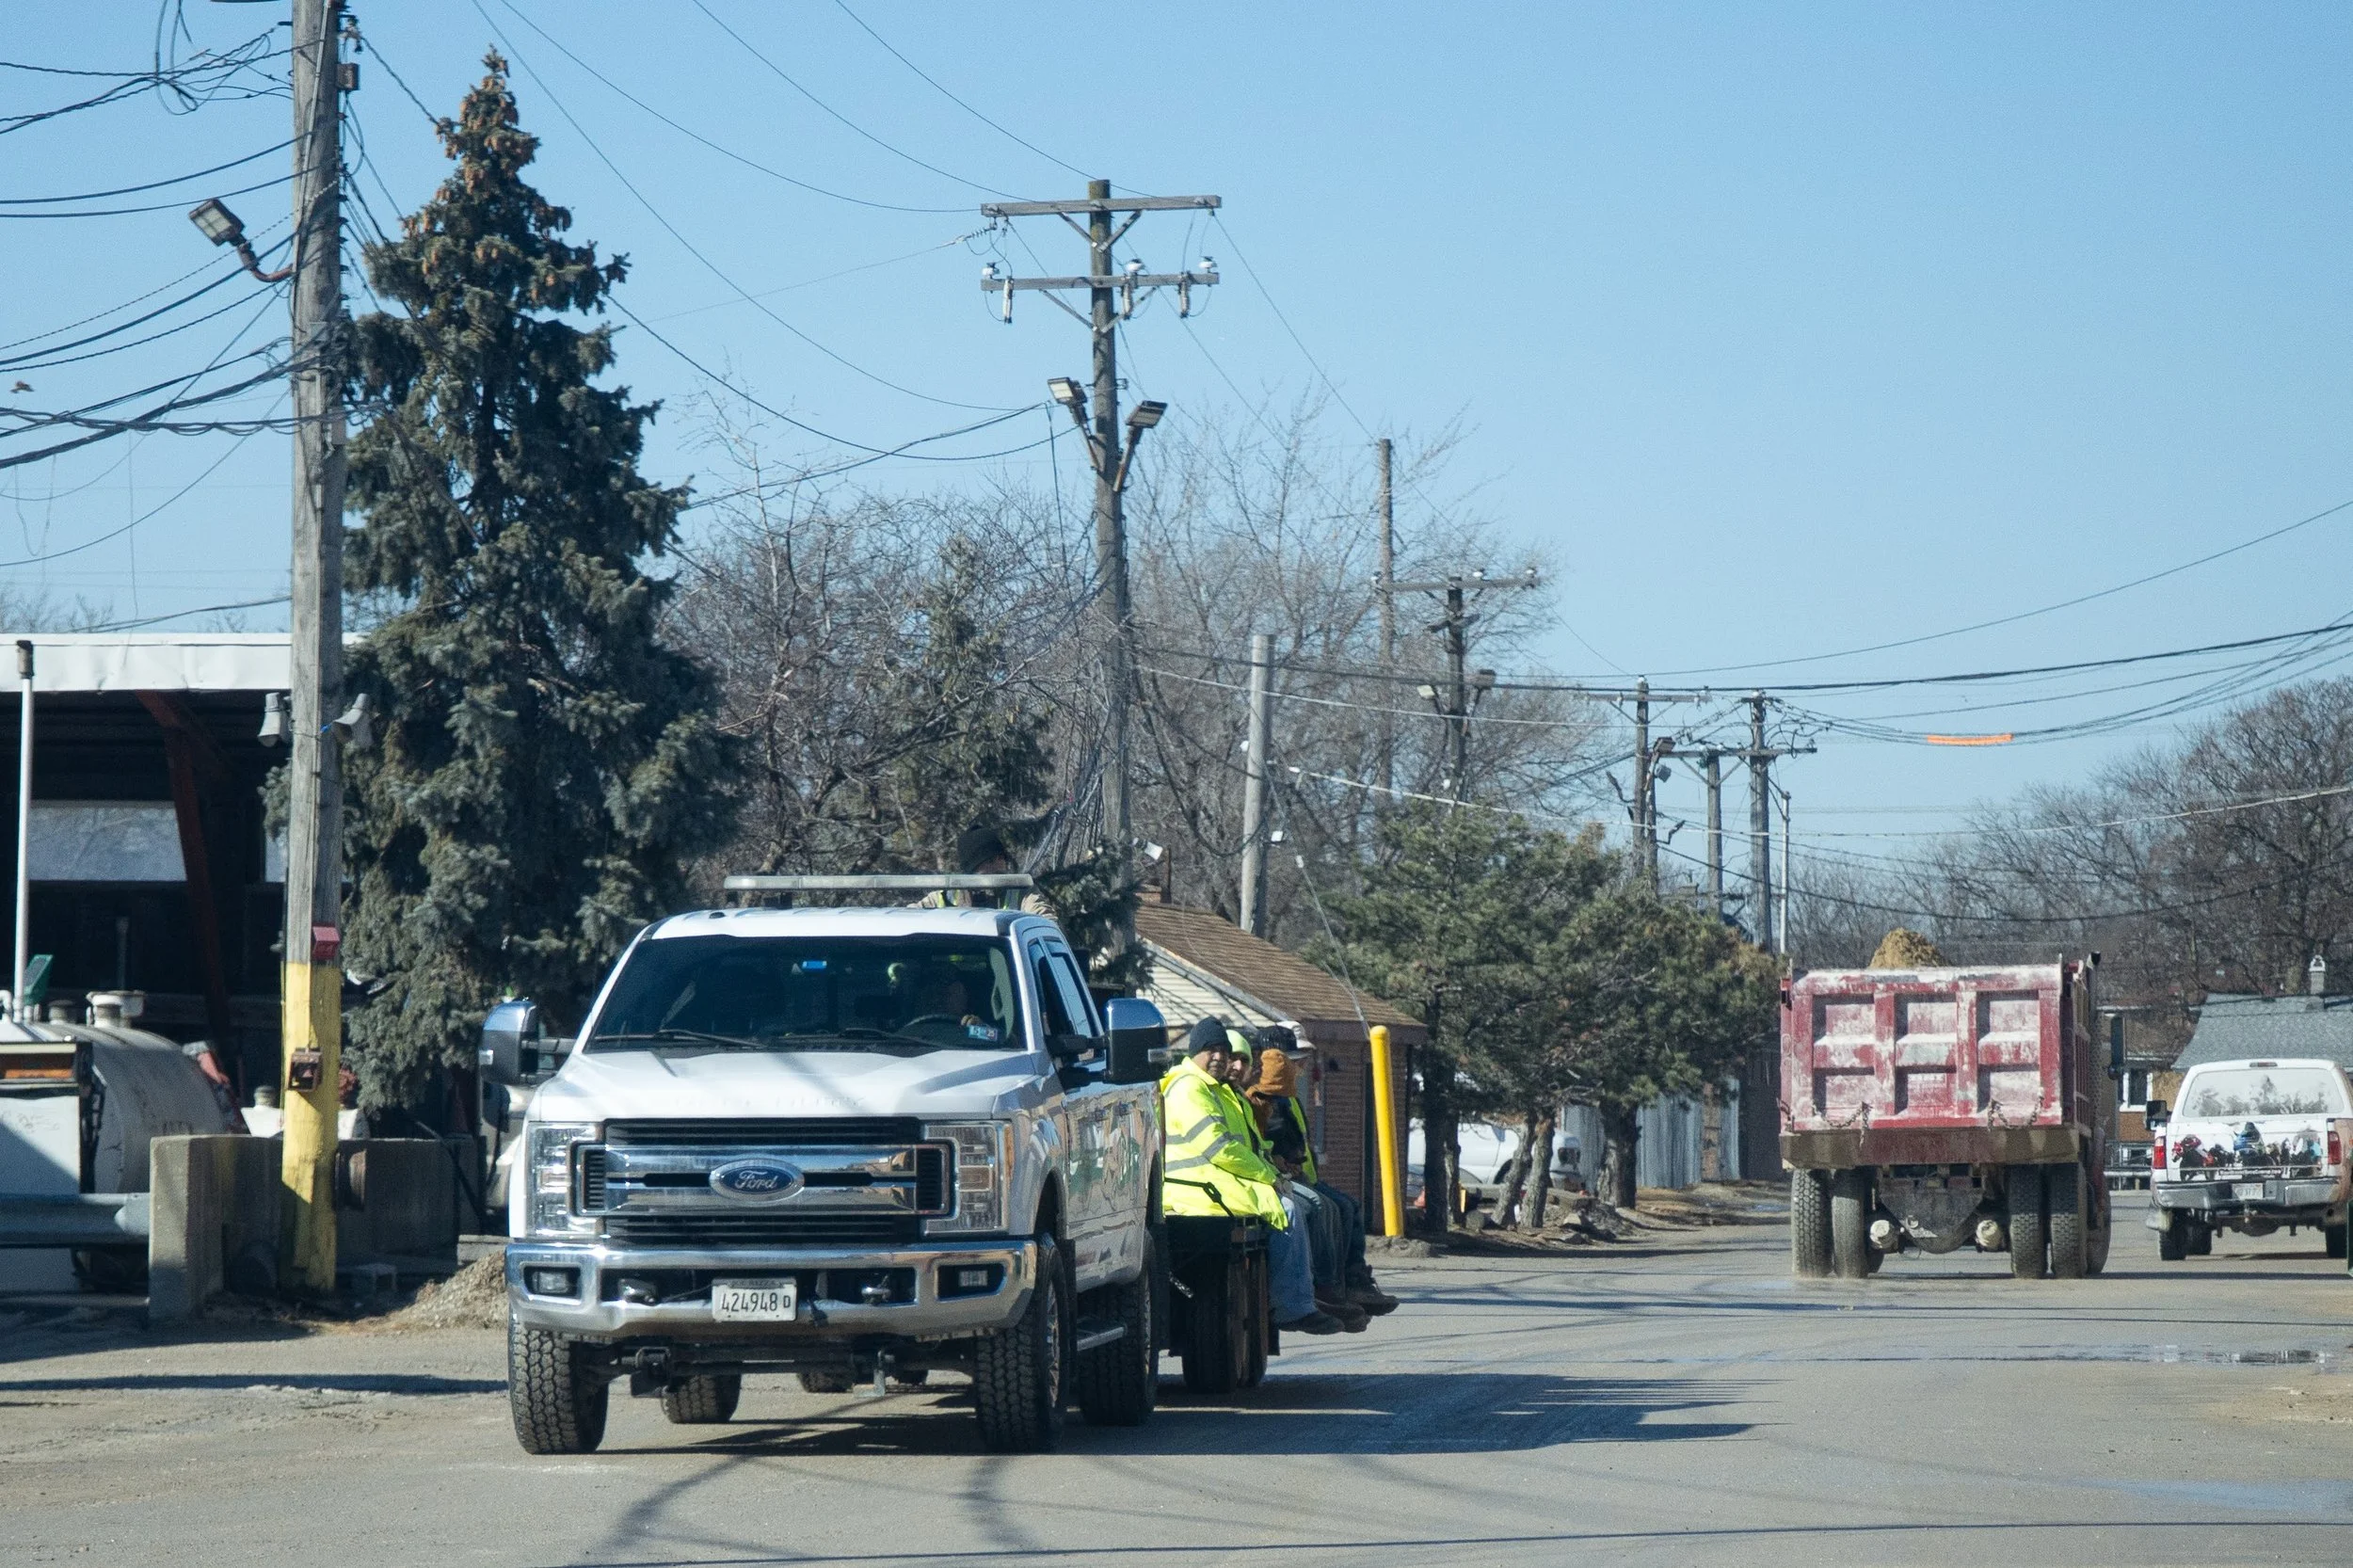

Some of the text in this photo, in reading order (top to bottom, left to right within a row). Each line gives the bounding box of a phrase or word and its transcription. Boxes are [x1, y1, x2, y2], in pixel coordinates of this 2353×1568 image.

[735, 1170, 777, 1190] Ford
[722, 1292, 791, 1312] 424948 D
